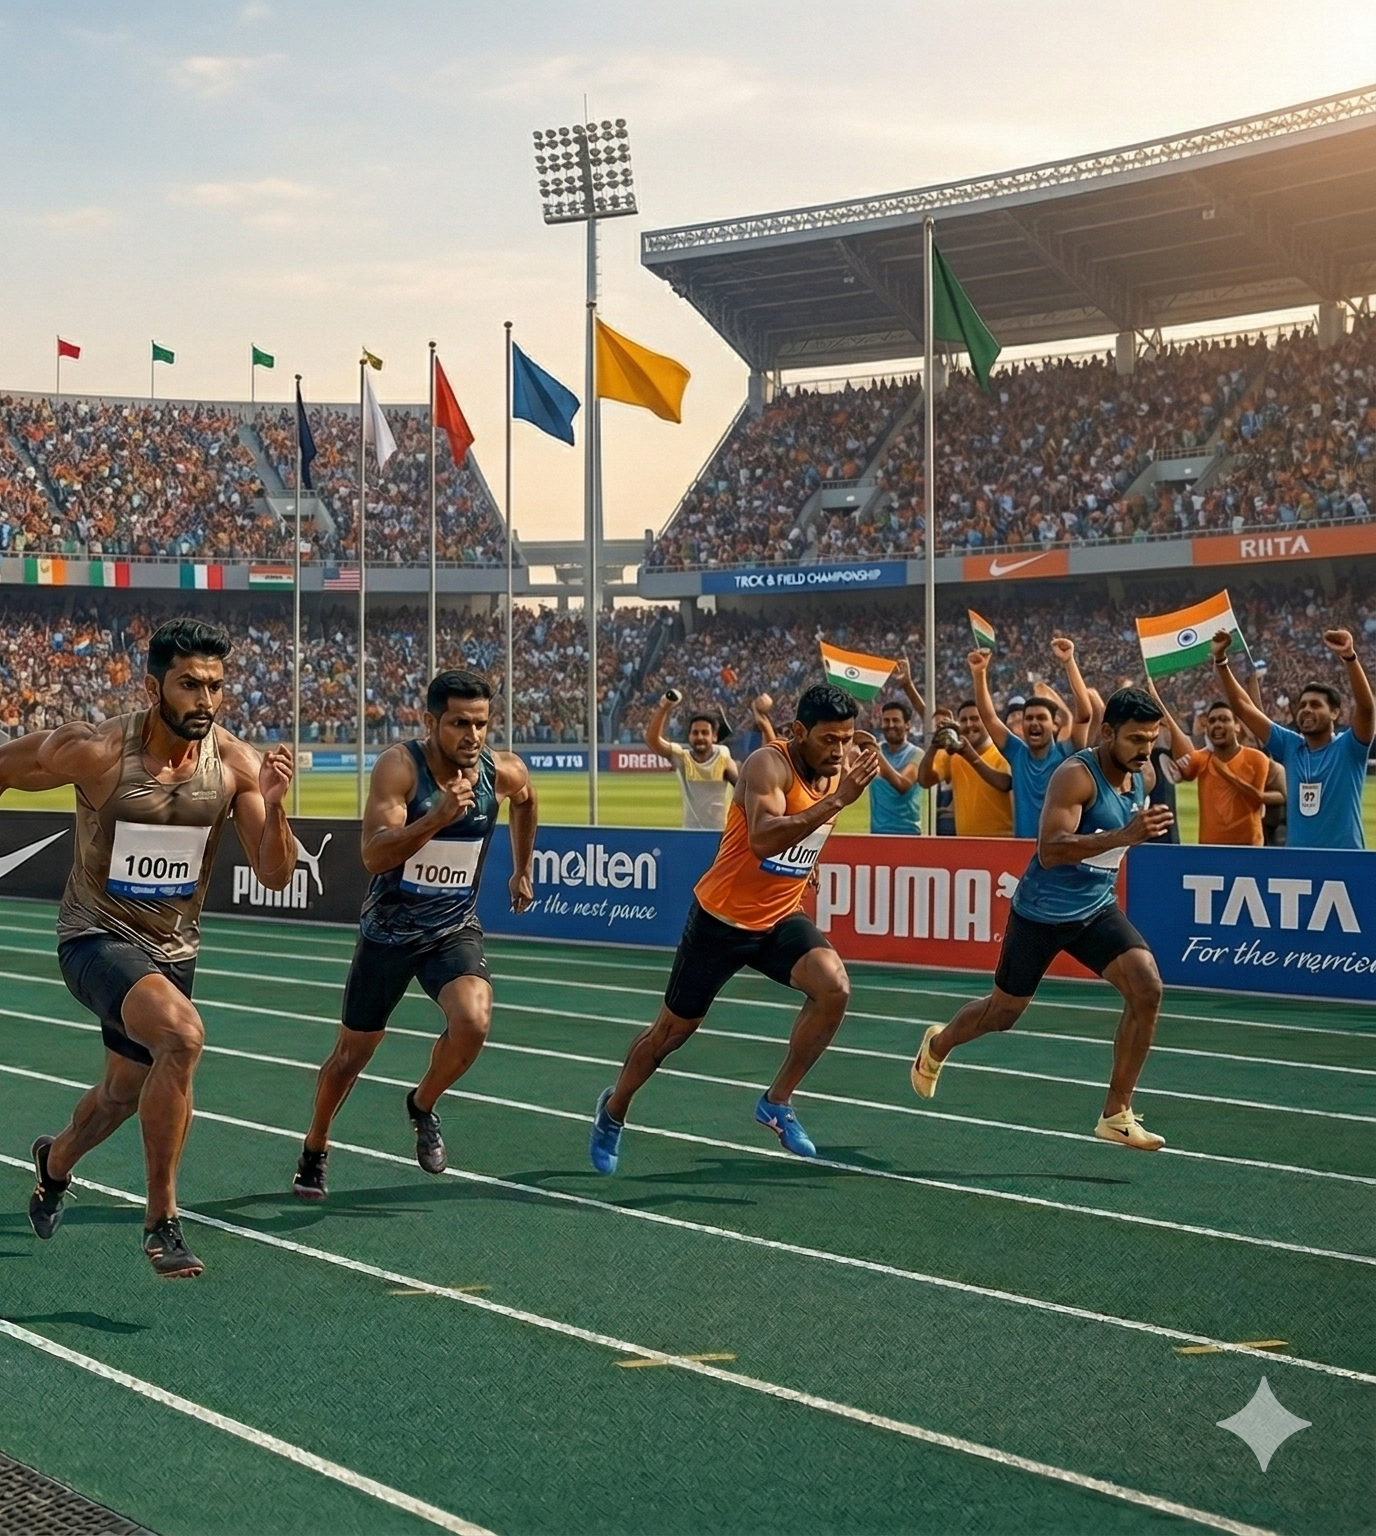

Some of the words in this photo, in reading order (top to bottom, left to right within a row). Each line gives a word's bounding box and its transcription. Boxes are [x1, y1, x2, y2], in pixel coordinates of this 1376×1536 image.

[777, 572, 805, 586] FIELD
[125, 855, 189, 879] 100m
[415, 863, 467, 884] 100m
[530, 844, 657, 890] molten
[543, 893, 571, 915] the
[815, 863, 991, 943] PUMA
[1182, 874, 1362, 934] TATA
[1181, 937, 1229, 963] For
[1233, 939, 1278, 966] the
